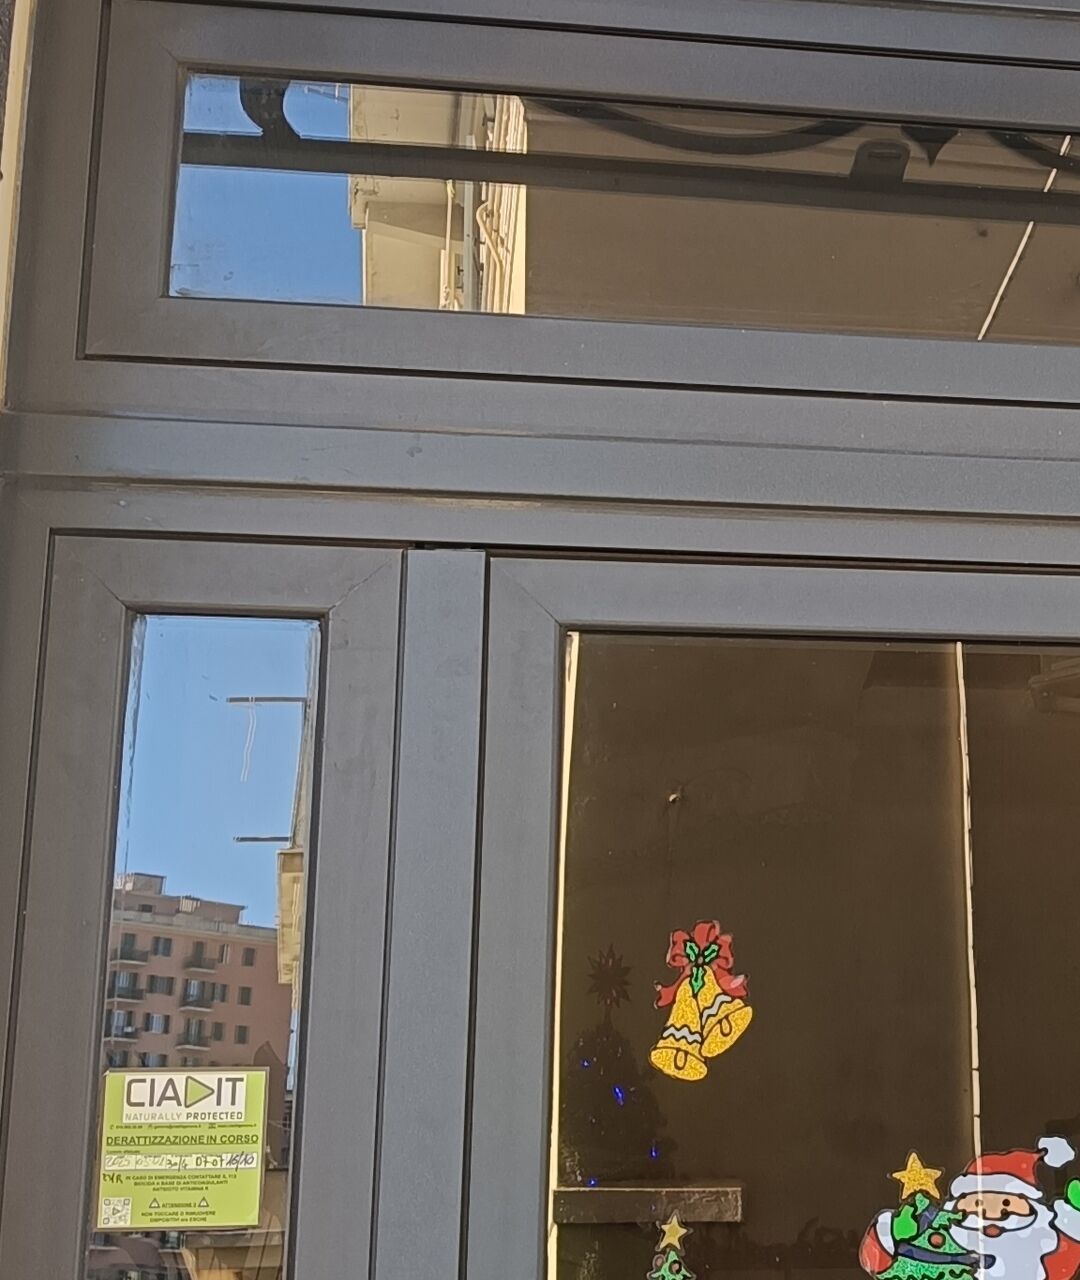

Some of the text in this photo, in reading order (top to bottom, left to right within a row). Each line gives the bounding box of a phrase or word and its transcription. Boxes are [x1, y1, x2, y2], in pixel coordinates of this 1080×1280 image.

[124, 1111, 243, 1121] NATURALLY PROTECTED
[105, 1134, 259, 1146] DERATTIZZAZIONE IN CORSO
